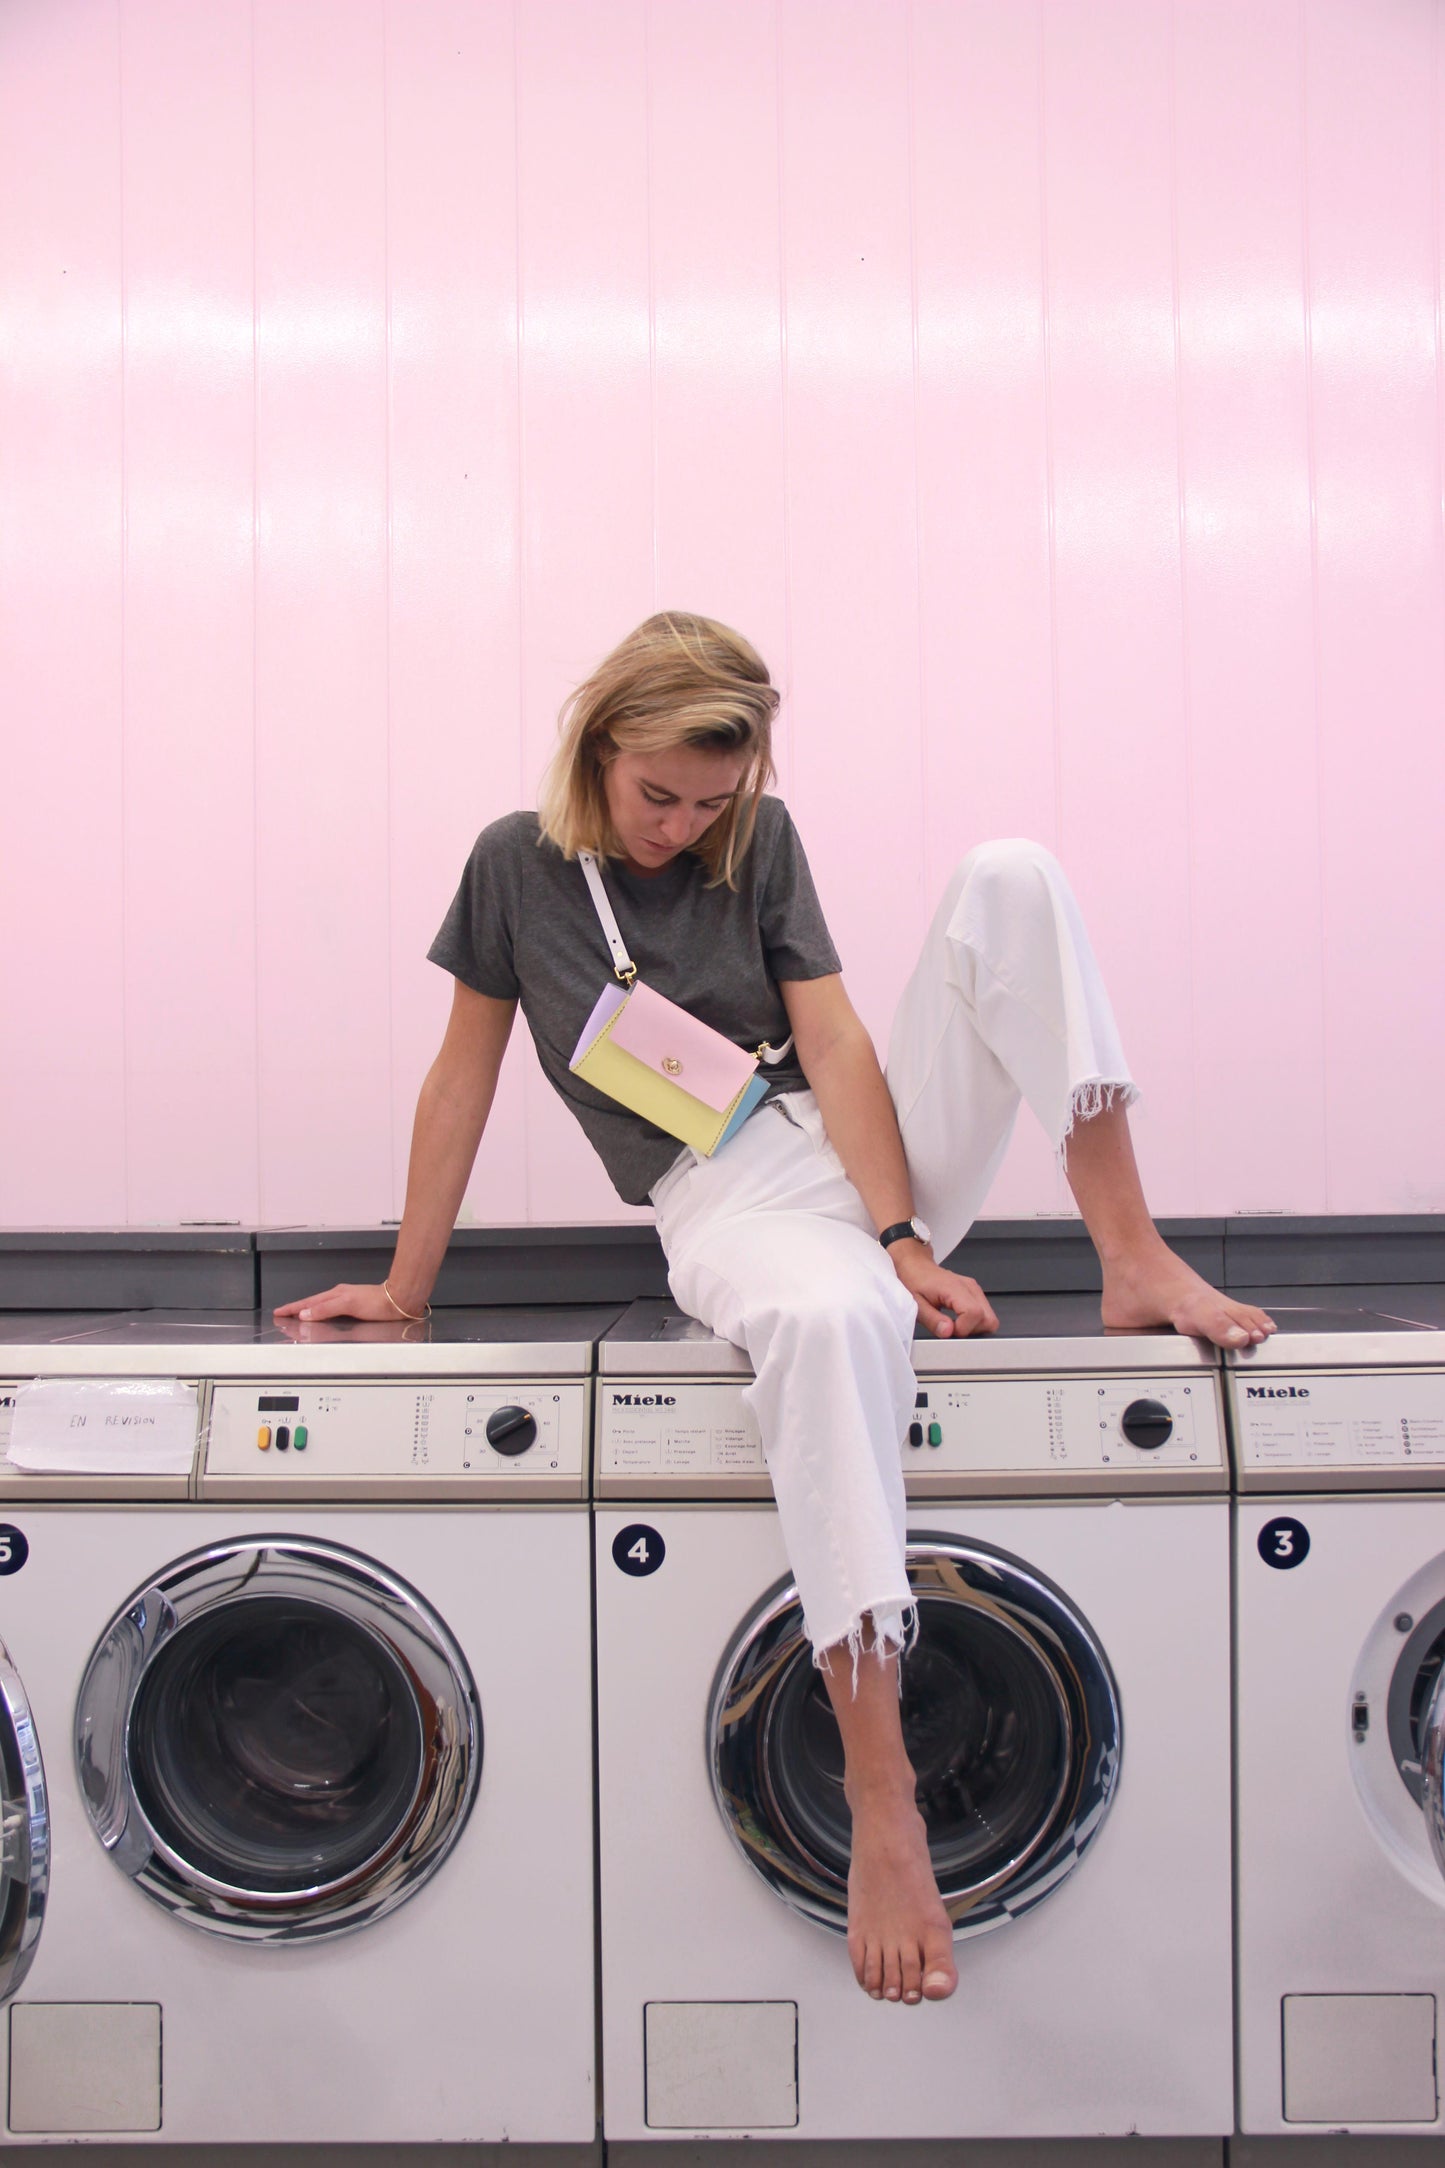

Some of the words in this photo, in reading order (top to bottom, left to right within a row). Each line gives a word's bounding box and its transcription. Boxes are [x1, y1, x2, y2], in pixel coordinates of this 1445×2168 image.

[612, 1394, 677, 1406] Miele
[1246, 1386, 1310, 1398] Miele
[70, 1414, 87, 1428] EN
[105, 1415, 156, 1426] REVISION
[0, 1537, 12, 1562] 5
[628, 1537, 649, 1563] 4
[1274, 1530, 1293, 1556] 3
